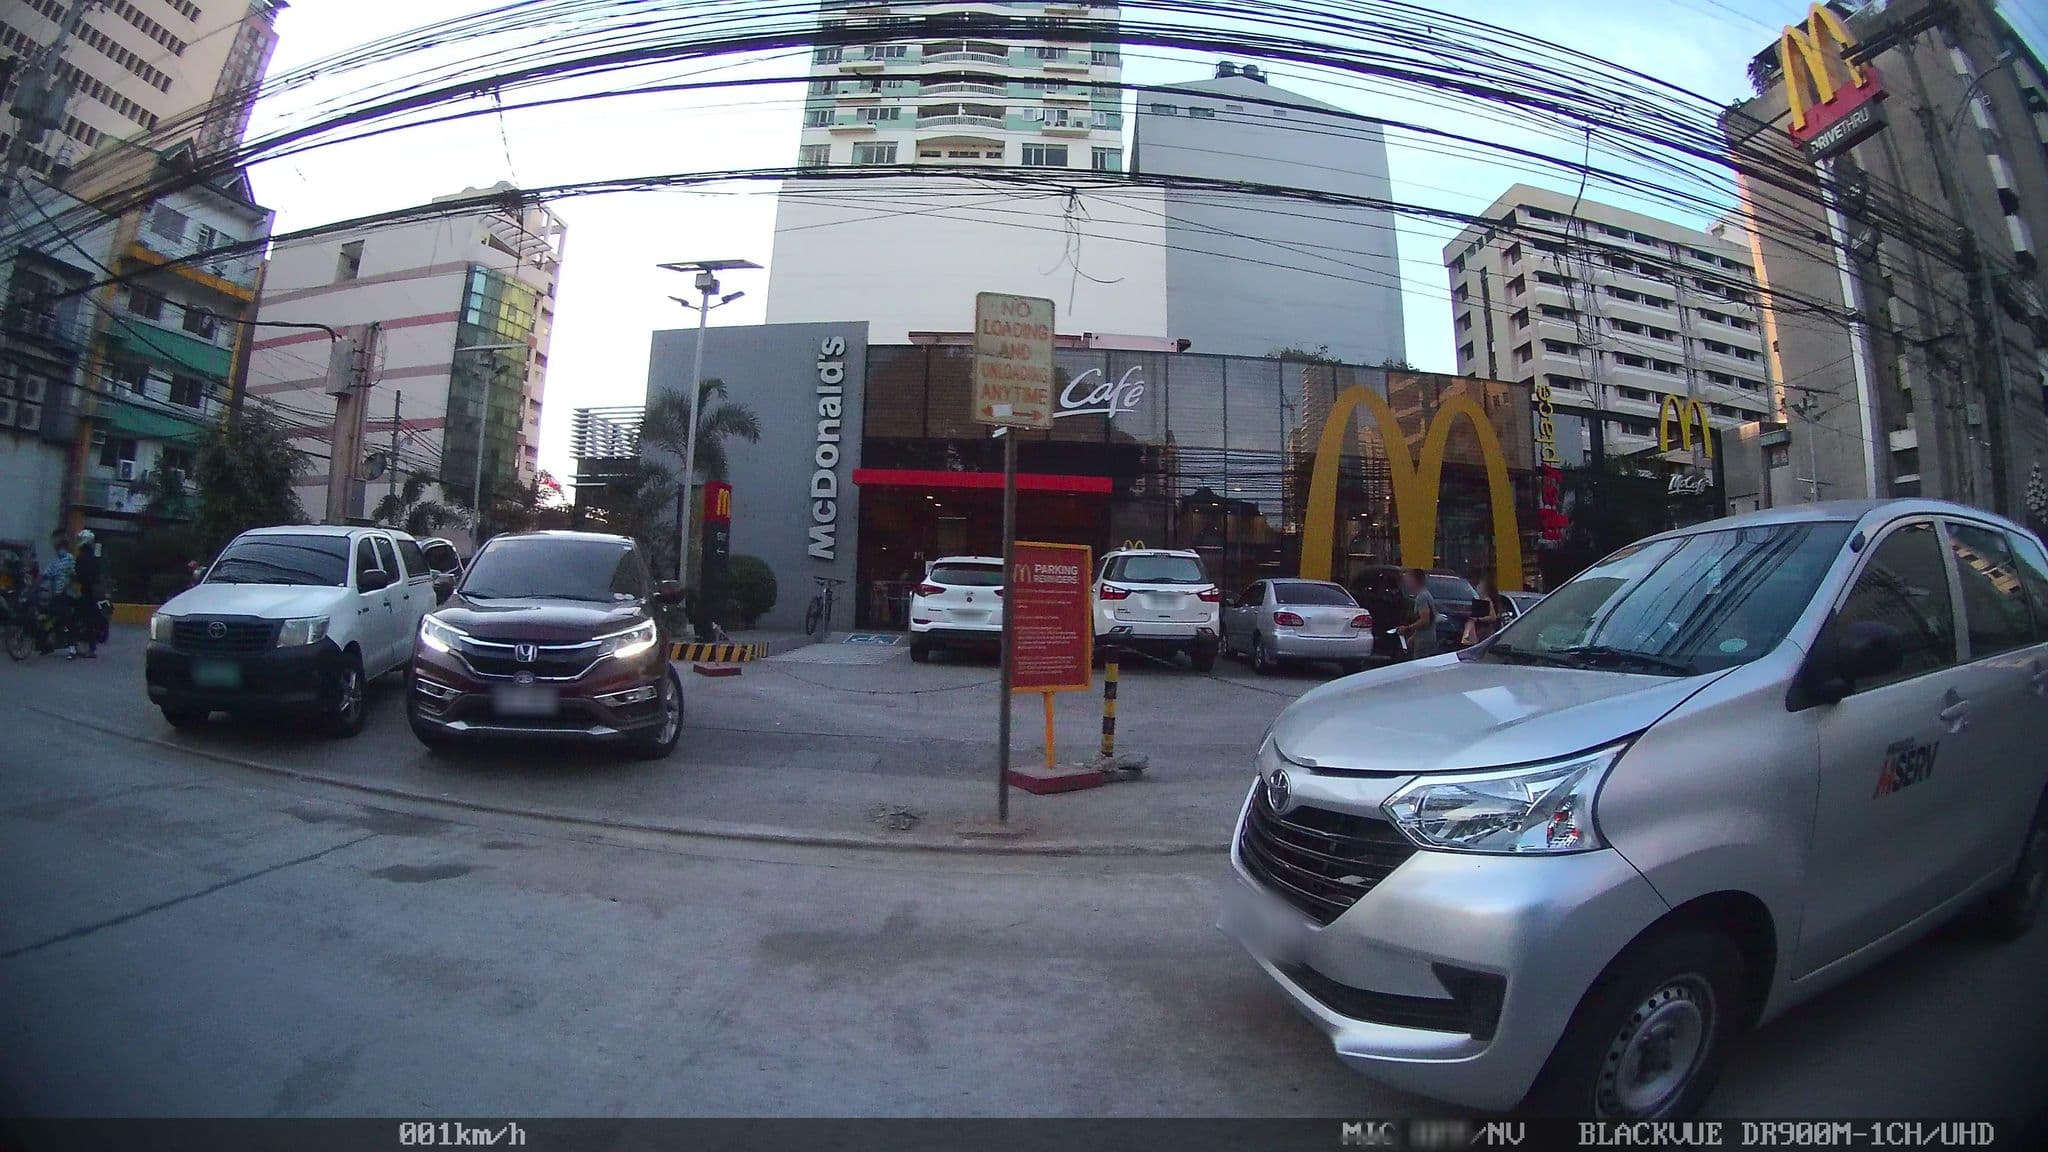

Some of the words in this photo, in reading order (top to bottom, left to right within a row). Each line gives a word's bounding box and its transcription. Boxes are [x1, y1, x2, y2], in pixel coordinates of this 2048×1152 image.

[1002, 301, 1031, 318] NO
[983, 319, 1049, 340] LOADING
[808, 335, 846, 560] McDonald's
[1034, 564, 1078, 576] PARKING
